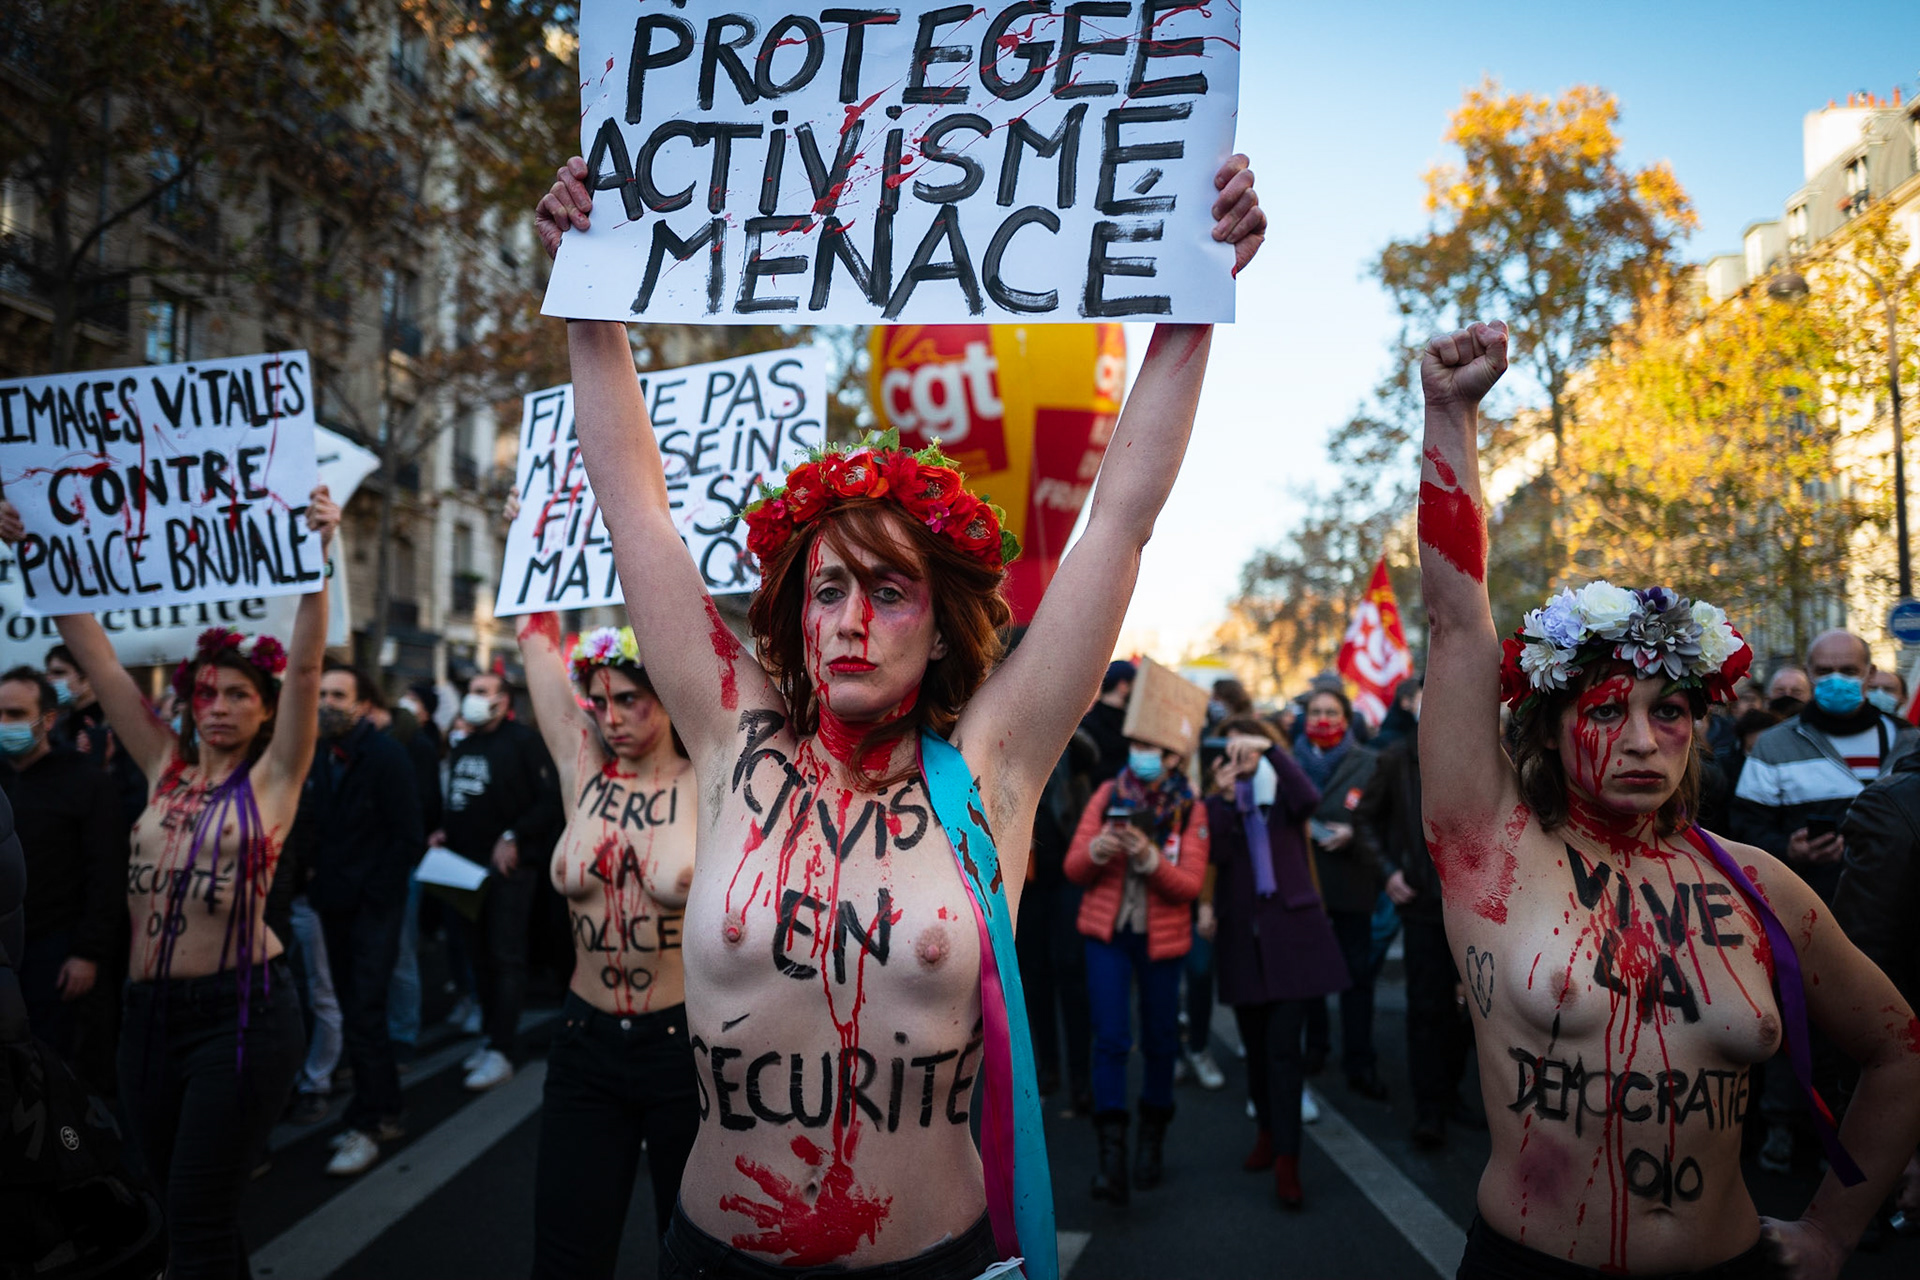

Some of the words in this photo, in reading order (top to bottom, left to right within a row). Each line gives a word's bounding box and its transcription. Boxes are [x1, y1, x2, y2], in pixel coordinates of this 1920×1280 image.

[0, 376, 145, 458] IMAGES
[701, 358, 806, 427] PAS
[881, 341, 1005, 445] cgt
[48, 446, 268, 526] CONTRE
[165, 504, 321, 592] BRUTALE
[772, 888, 891, 984] EN
